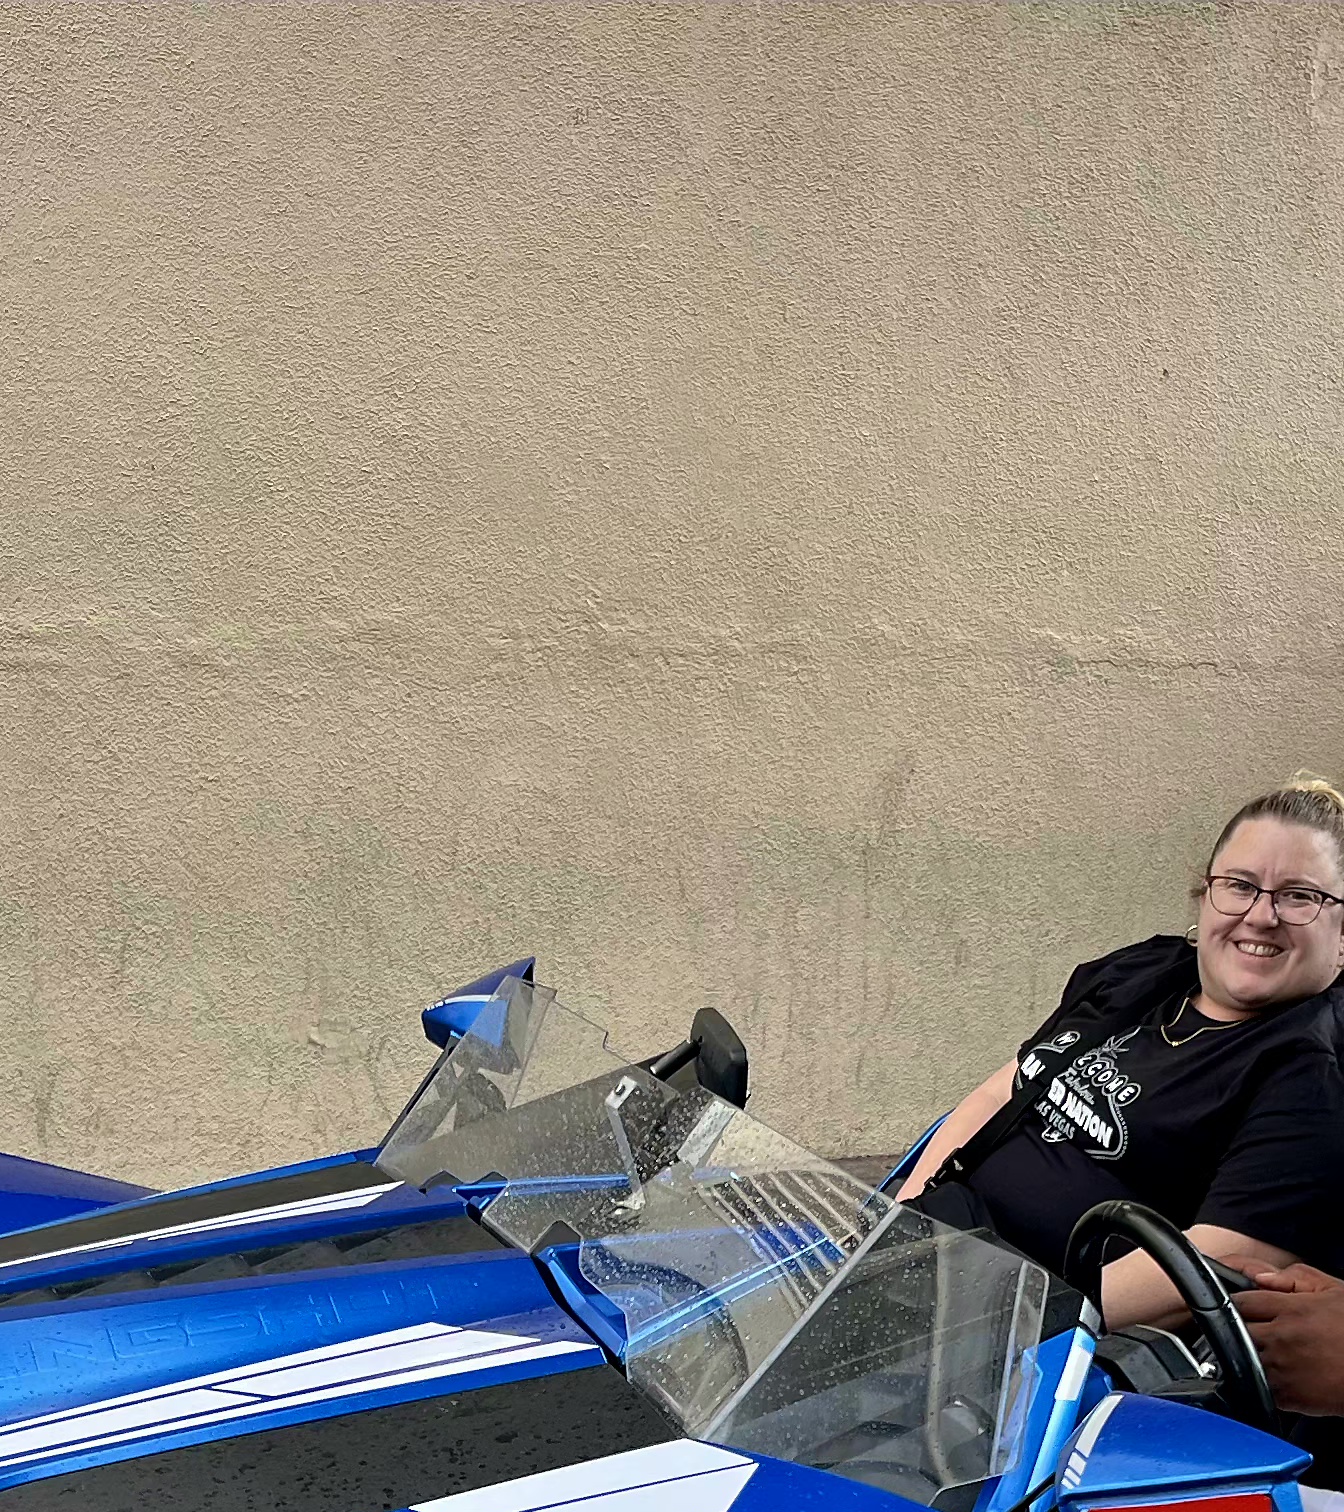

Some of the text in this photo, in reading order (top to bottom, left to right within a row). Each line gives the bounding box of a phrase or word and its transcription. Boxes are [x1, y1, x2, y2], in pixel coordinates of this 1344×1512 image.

[1052, 1031, 1141, 1107] WLCOME
[1049, 1109, 1076, 1139] VEGAS
[1061, 1090, 1113, 1148] NATION
